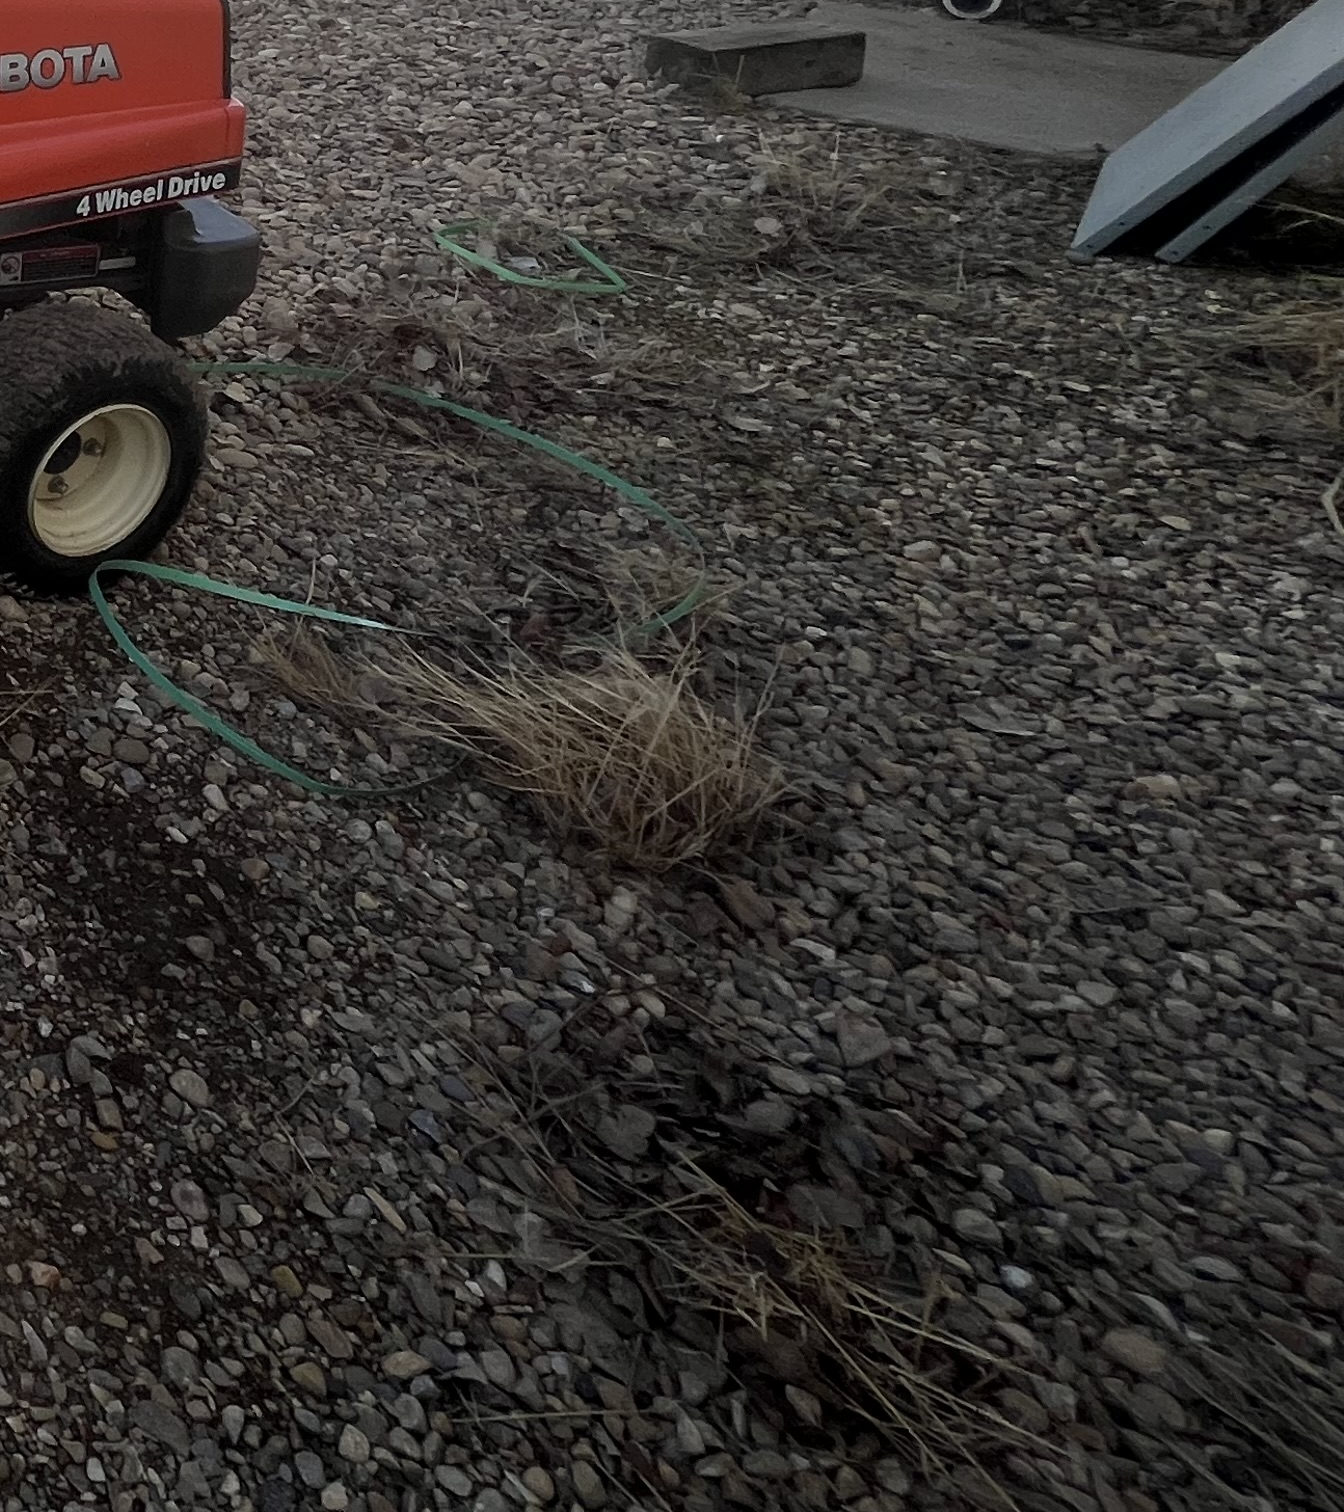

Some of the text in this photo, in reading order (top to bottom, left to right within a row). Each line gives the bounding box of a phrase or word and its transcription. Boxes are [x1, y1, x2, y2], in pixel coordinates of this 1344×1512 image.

[76, 171, 226, 217] 4 Wheel Drive
